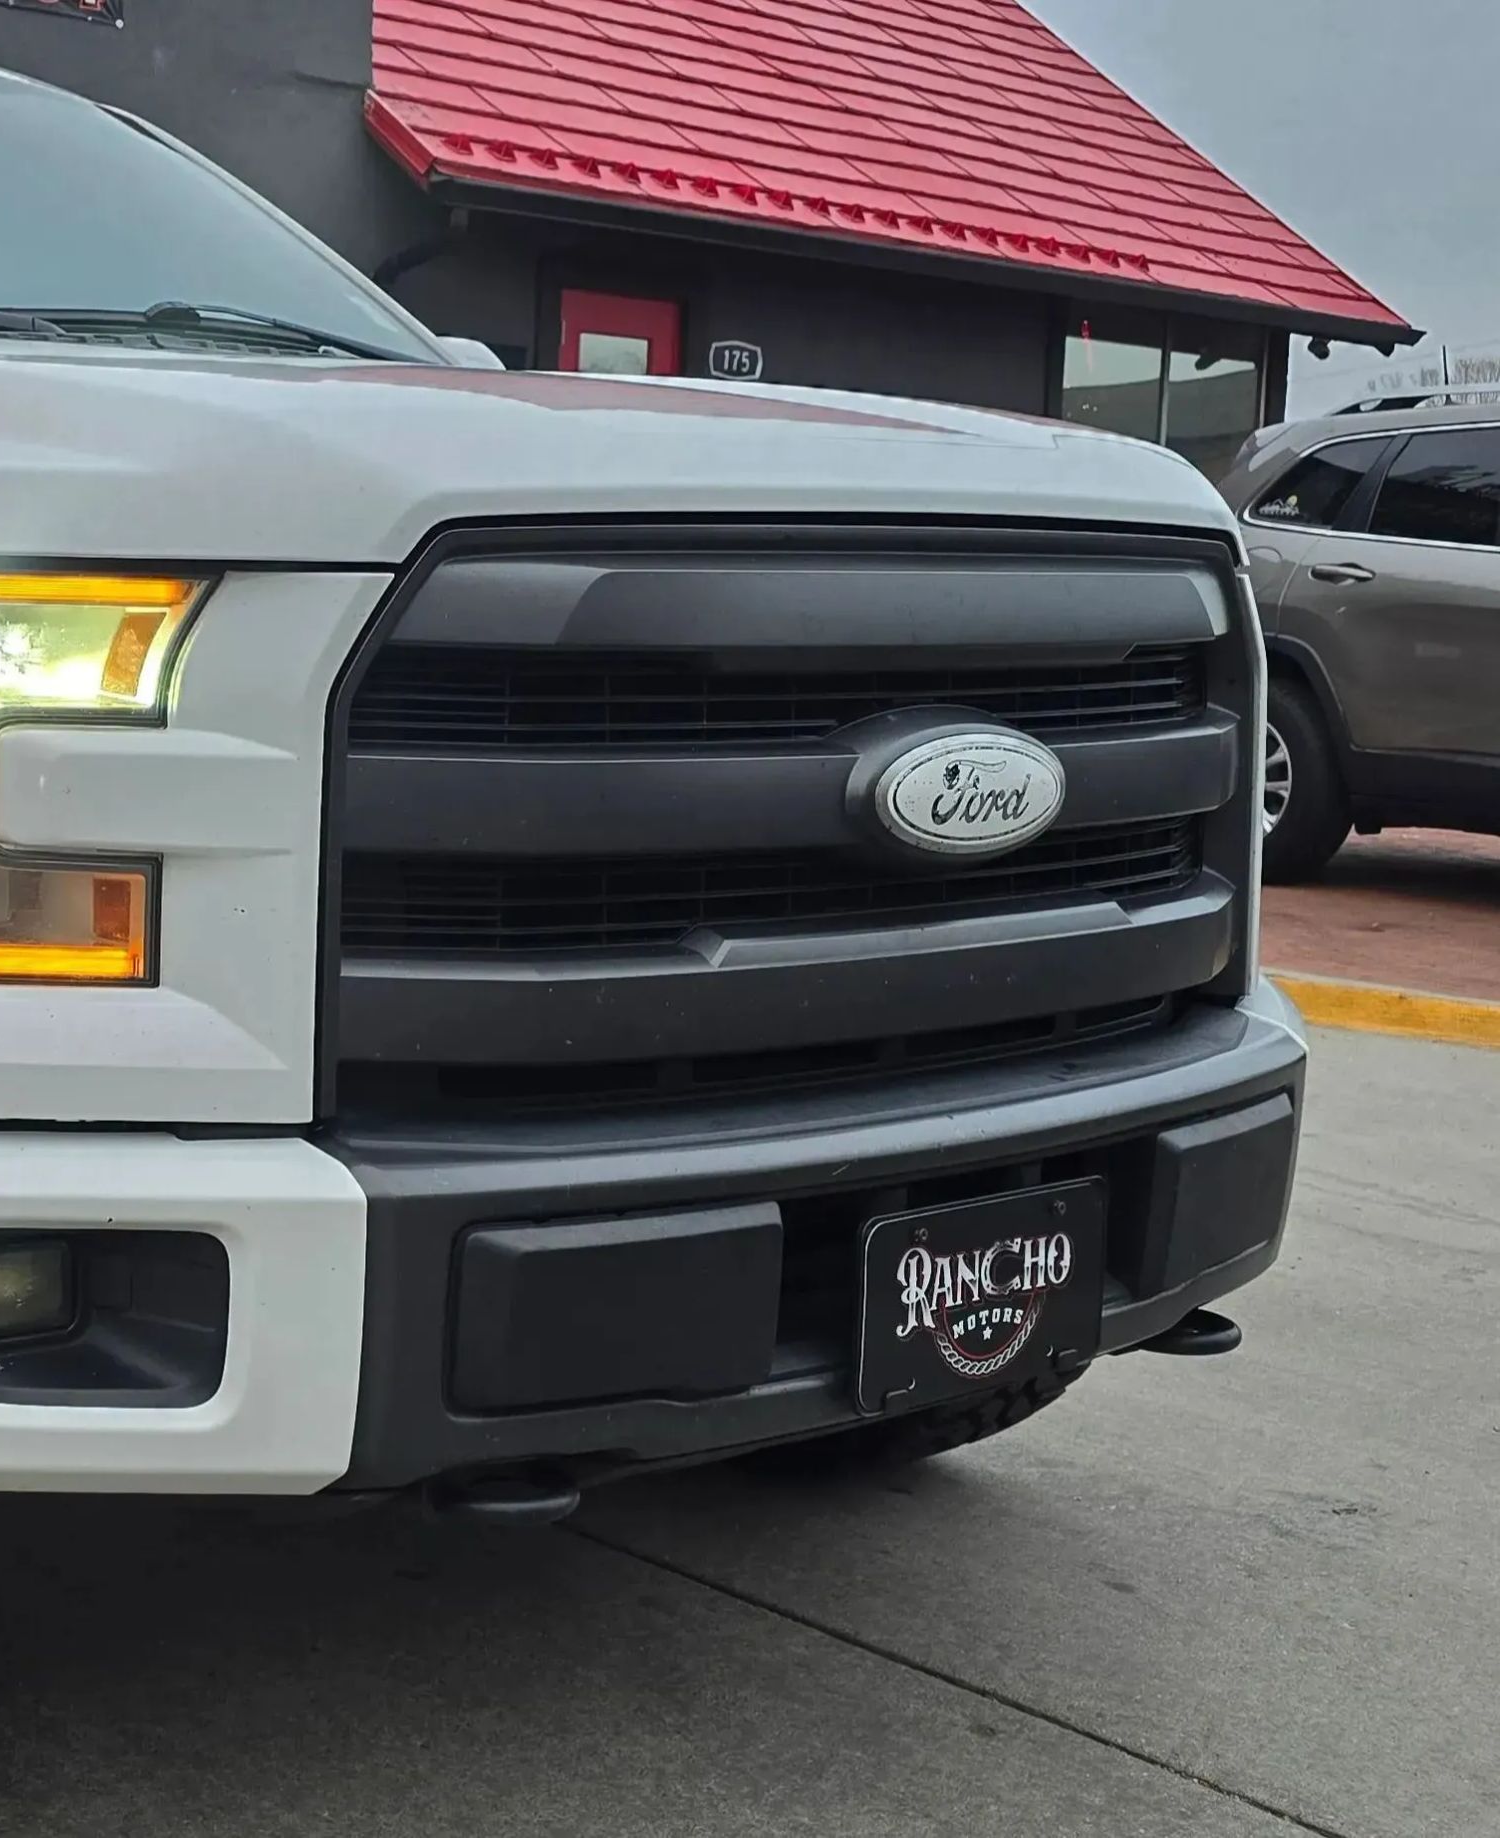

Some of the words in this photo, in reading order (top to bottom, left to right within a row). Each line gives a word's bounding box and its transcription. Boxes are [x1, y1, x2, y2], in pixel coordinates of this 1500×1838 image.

[723, 349, 750, 372] 175
[931, 759, 1032, 826] Ford
[896, 1233, 1072, 1338] RANCHO
[952, 1307, 1024, 1340] MOTORS
